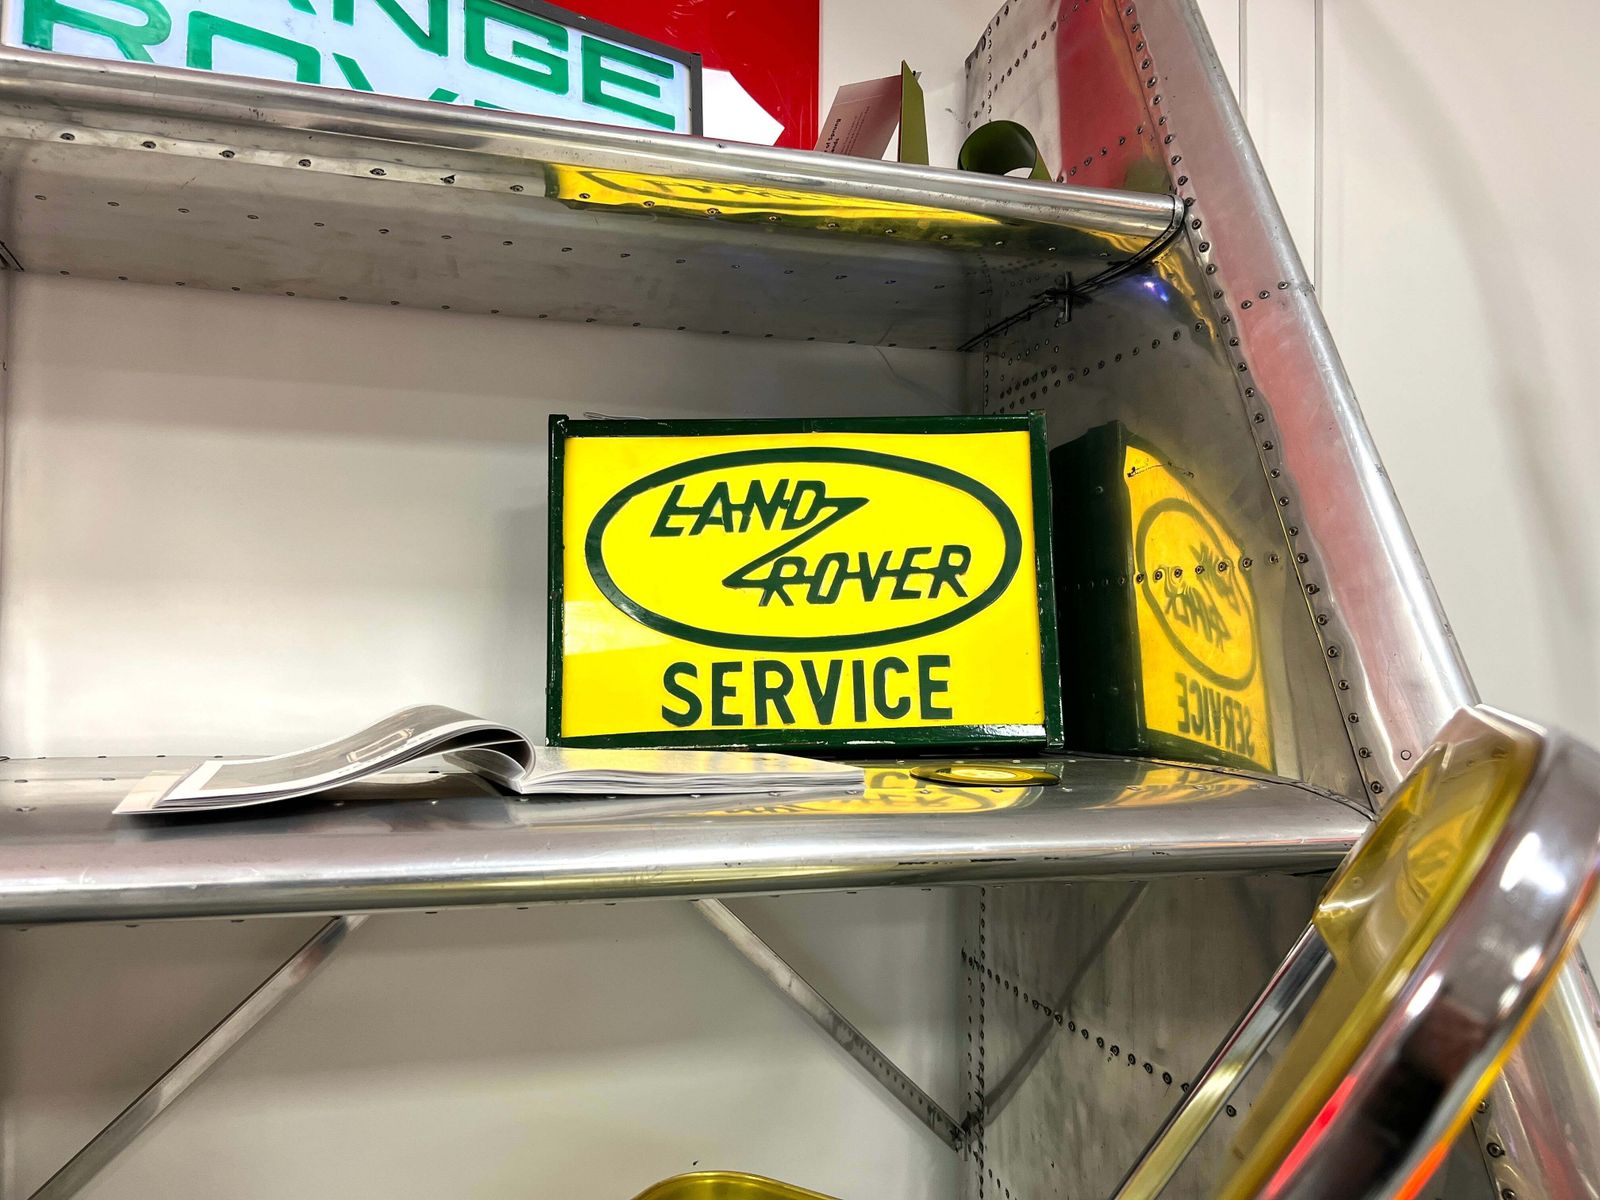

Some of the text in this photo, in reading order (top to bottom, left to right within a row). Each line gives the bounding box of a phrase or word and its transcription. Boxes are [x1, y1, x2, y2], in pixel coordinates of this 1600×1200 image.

[650, 478, 827, 537] LAND
[756, 544, 971, 607] ROVER
[661, 655, 953, 728] SERVICE
